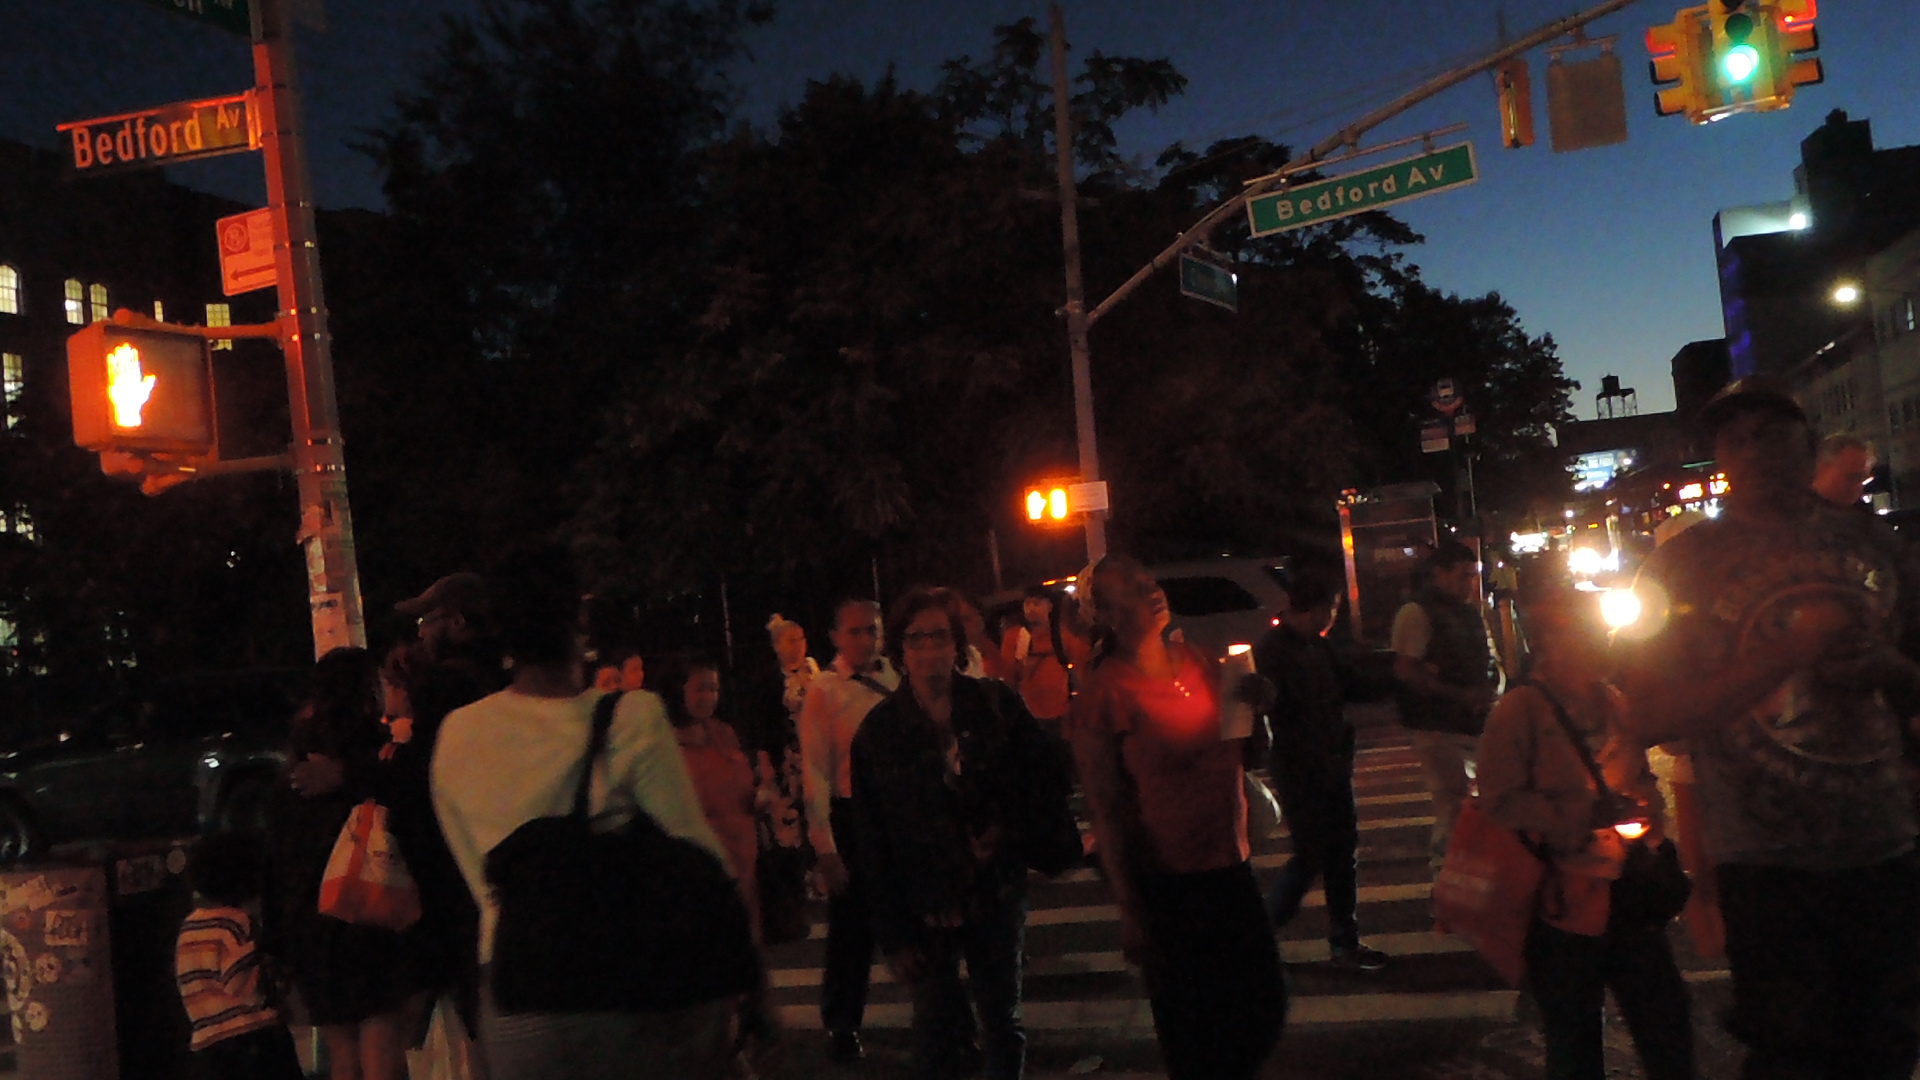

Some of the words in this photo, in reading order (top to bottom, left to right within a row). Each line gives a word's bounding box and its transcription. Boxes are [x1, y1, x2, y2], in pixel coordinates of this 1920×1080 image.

[72, 110, 203, 169] Bedford
[216, 104, 241, 131] Av
[1276, 174, 1397, 221] Bedford
[1407, 161, 1445, 189] Av
